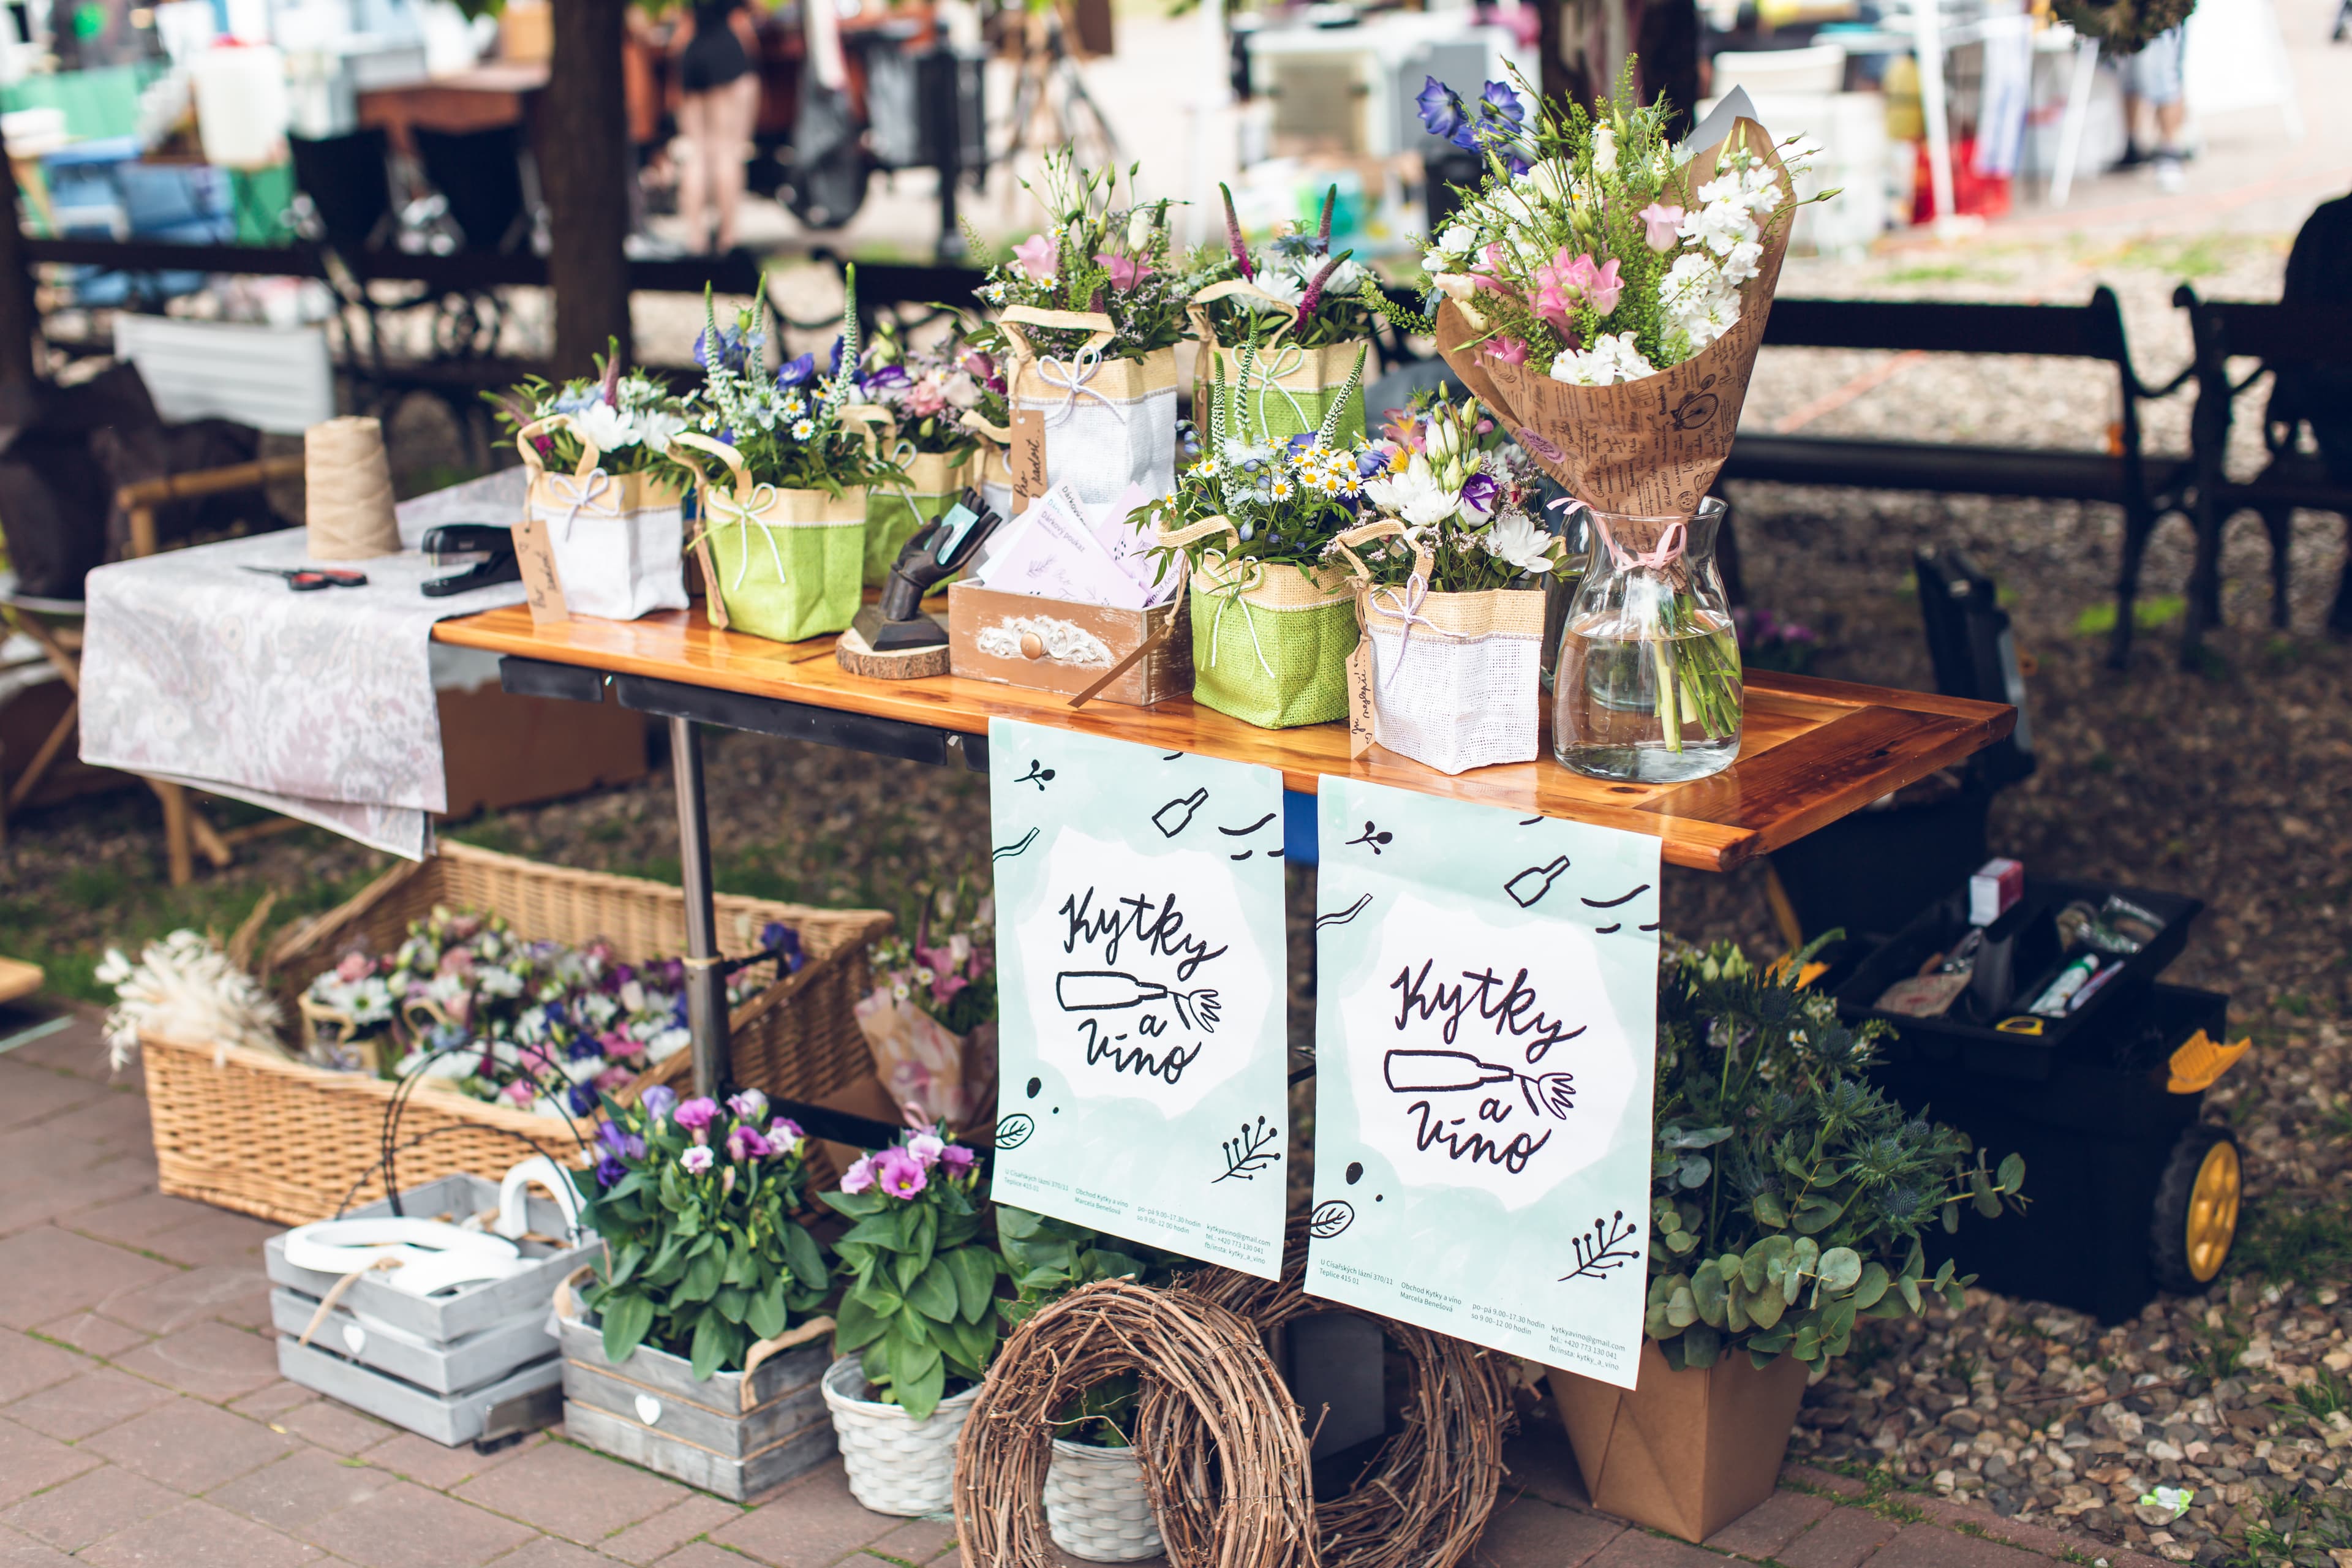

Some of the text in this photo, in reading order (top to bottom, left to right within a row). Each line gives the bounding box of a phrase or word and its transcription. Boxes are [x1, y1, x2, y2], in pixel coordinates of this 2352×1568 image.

[1059, 886, 1227, 980] Kytky
[1390, 959, 1586, 1063] Kytky
[1139, 1014, 1167, 1037] a
[1479, 1098, 1512, 1123] a
[1320, 1268, 1340, 1279] Teplice
[1373, 1274, 1392, 1285] 370/11
[1401, 1282, 1424, 1294] Obchod
[1426, 1289, 1442, 1300] Kytky
[1401, 1291, 1452, 1312] Marcela Benešová
[1513, 1324, 1531, 1335] hodin
[1527, 1318, 1545, 1329] hodin
[1552, 1325, 1625, 1351] kytkyavino@gmail.com
[1581, 1343, 1591, 1352] 773
[1549, 1344, 1619, 1370] fb/insta: kytky_a_vino
